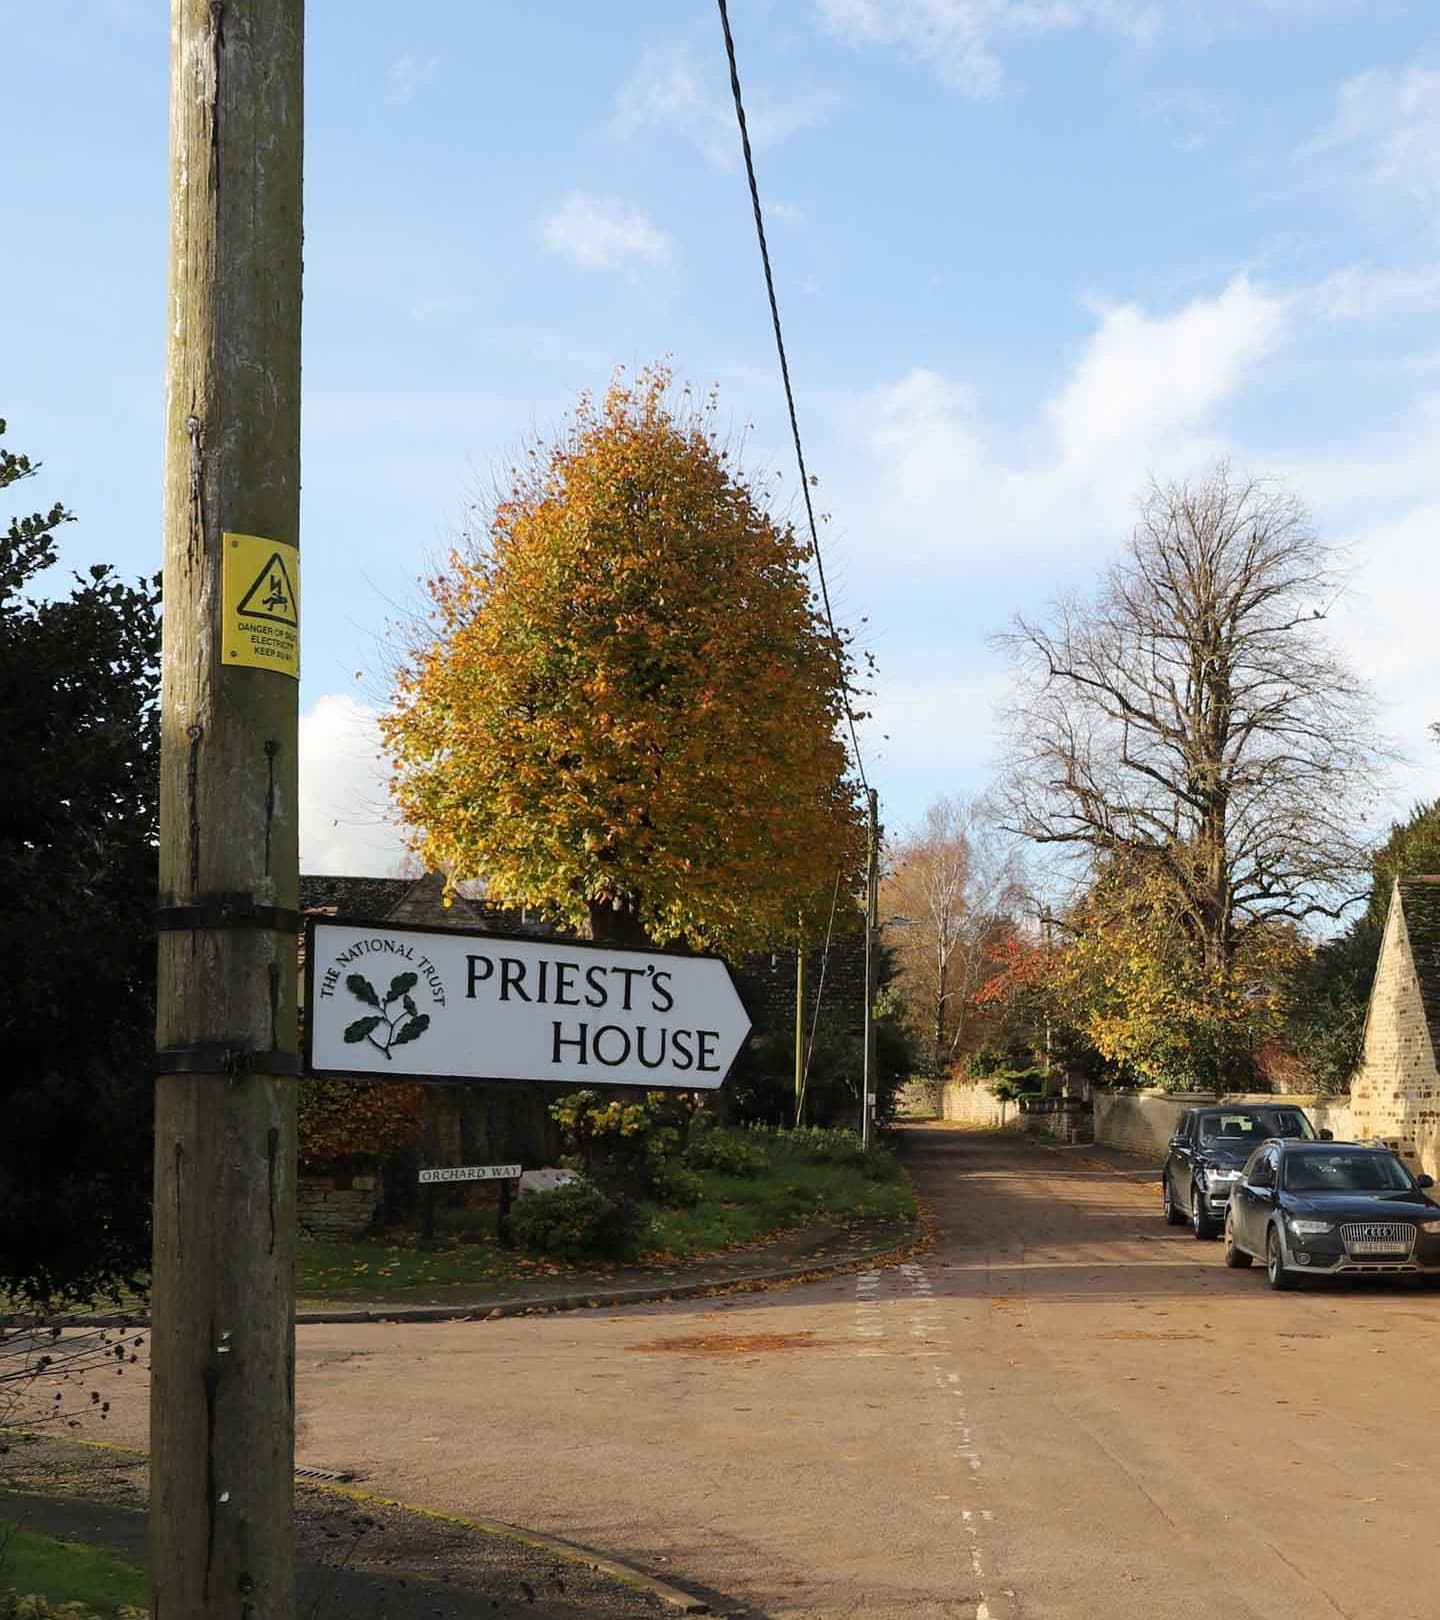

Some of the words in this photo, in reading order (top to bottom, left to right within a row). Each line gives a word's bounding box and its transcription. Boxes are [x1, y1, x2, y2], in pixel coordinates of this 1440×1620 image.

[238, 622, 273, 635] DANGER
[250, 635, 294, 650] ELECTRIC
[254, 646, 275, 657] KEEP
[320, 967, 341, 999] THE
[335, 938, 414, 968] NATIONAL
[417, 956, 446, 1007] TRUST
[465, 954, 674, 1013] PRIEST'S
[552, 1021, 721, 1072] HOUSE
[422, 1168, 486, 1181] ORCHARD
[491, 1166, 519, 1177] WAY
